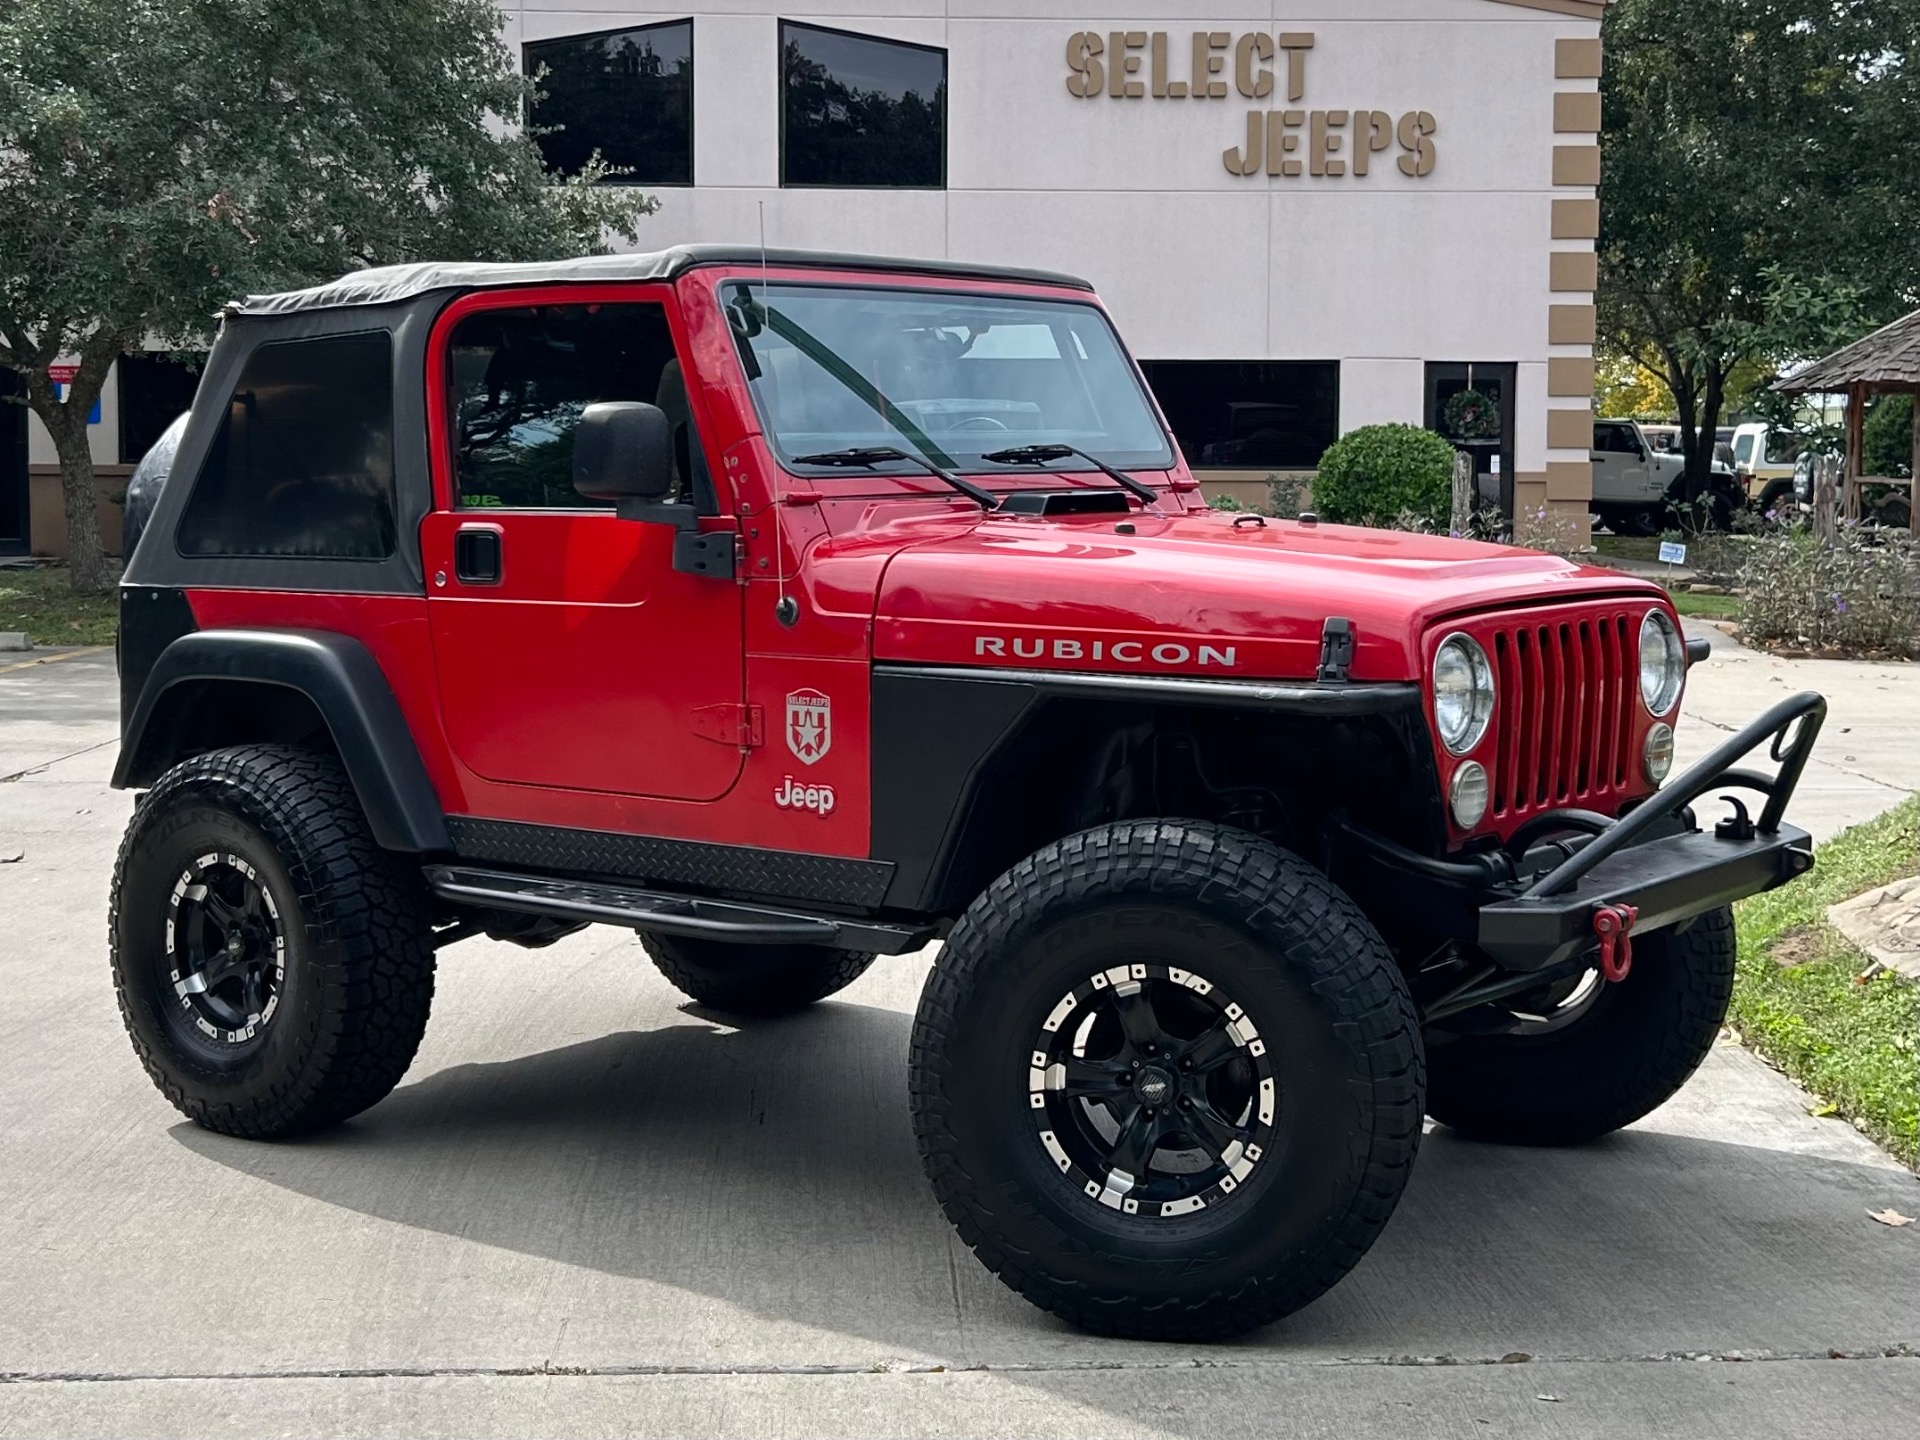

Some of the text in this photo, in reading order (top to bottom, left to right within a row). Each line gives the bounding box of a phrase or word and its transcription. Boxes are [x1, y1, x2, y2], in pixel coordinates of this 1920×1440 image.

[1066, 31, 1315, 101] SELECT
[1222, 110, 1437, 176] JEEPS
[975, 636, 1236, 666] RUBICON
[788, 696, 811, 705] SELECT
[774, 775, 835, 816] Jeep
